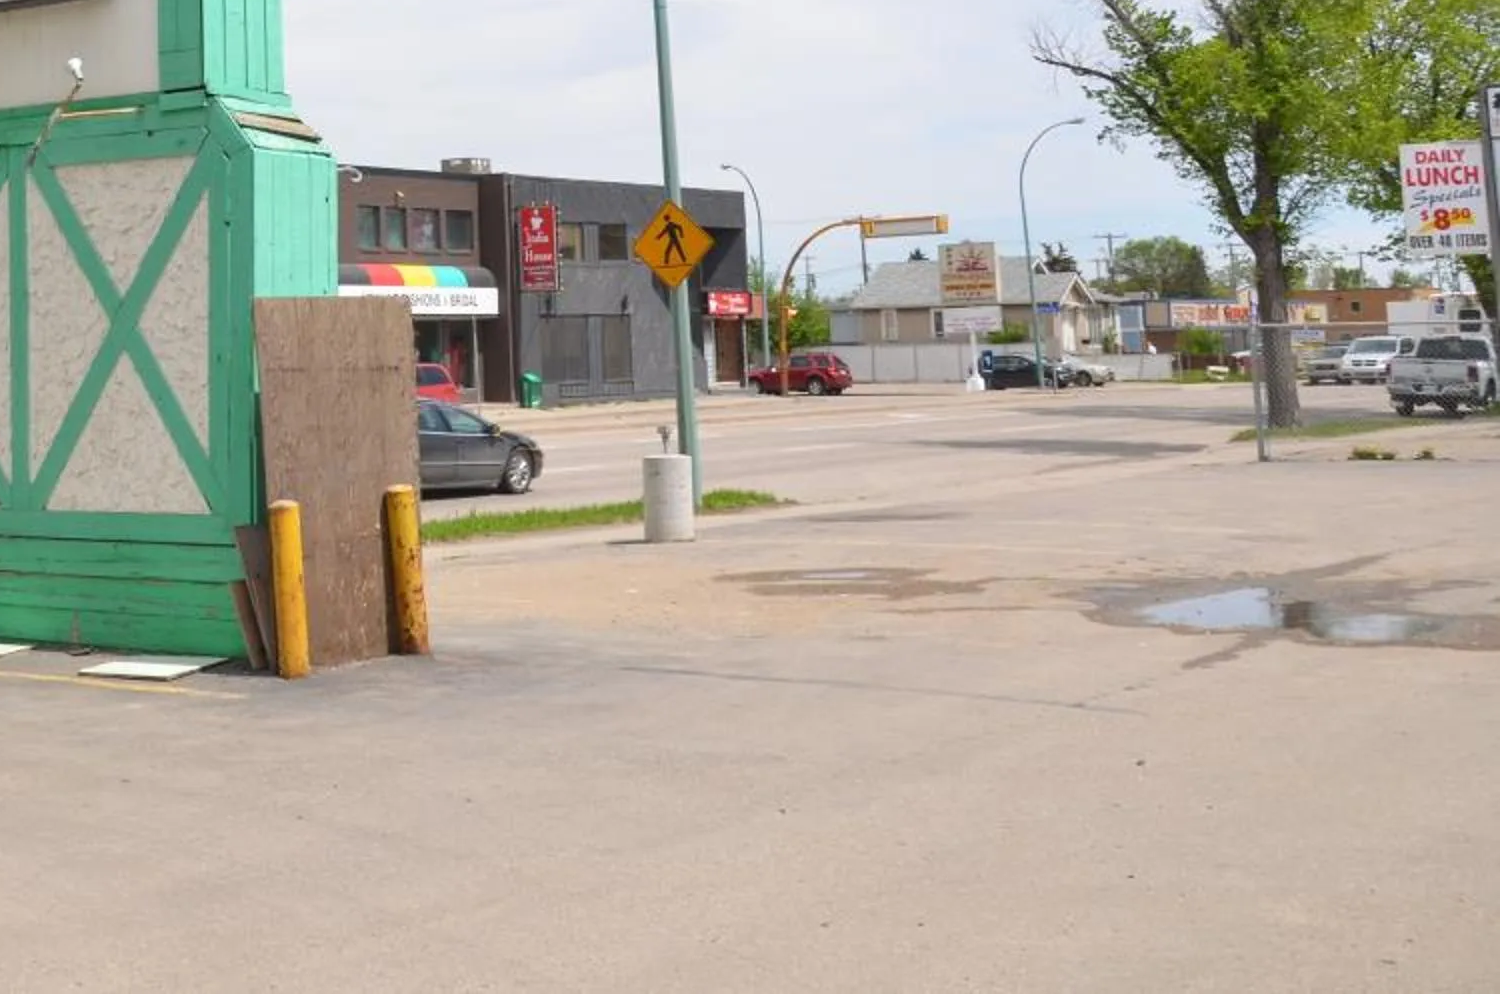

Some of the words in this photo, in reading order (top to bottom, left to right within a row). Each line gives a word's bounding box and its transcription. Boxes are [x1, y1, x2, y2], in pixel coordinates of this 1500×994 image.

[1415, 149, 1464, 164] DAILY
[1406, 166, 1479, 187] LUNCH
[1410, 186, 1481, 209] Specials
[1410, 235, 1433, 248] OVER
[1455, 233, 1487, 247] ITEMS
[450, 293, 479, 306] BRIDAL
